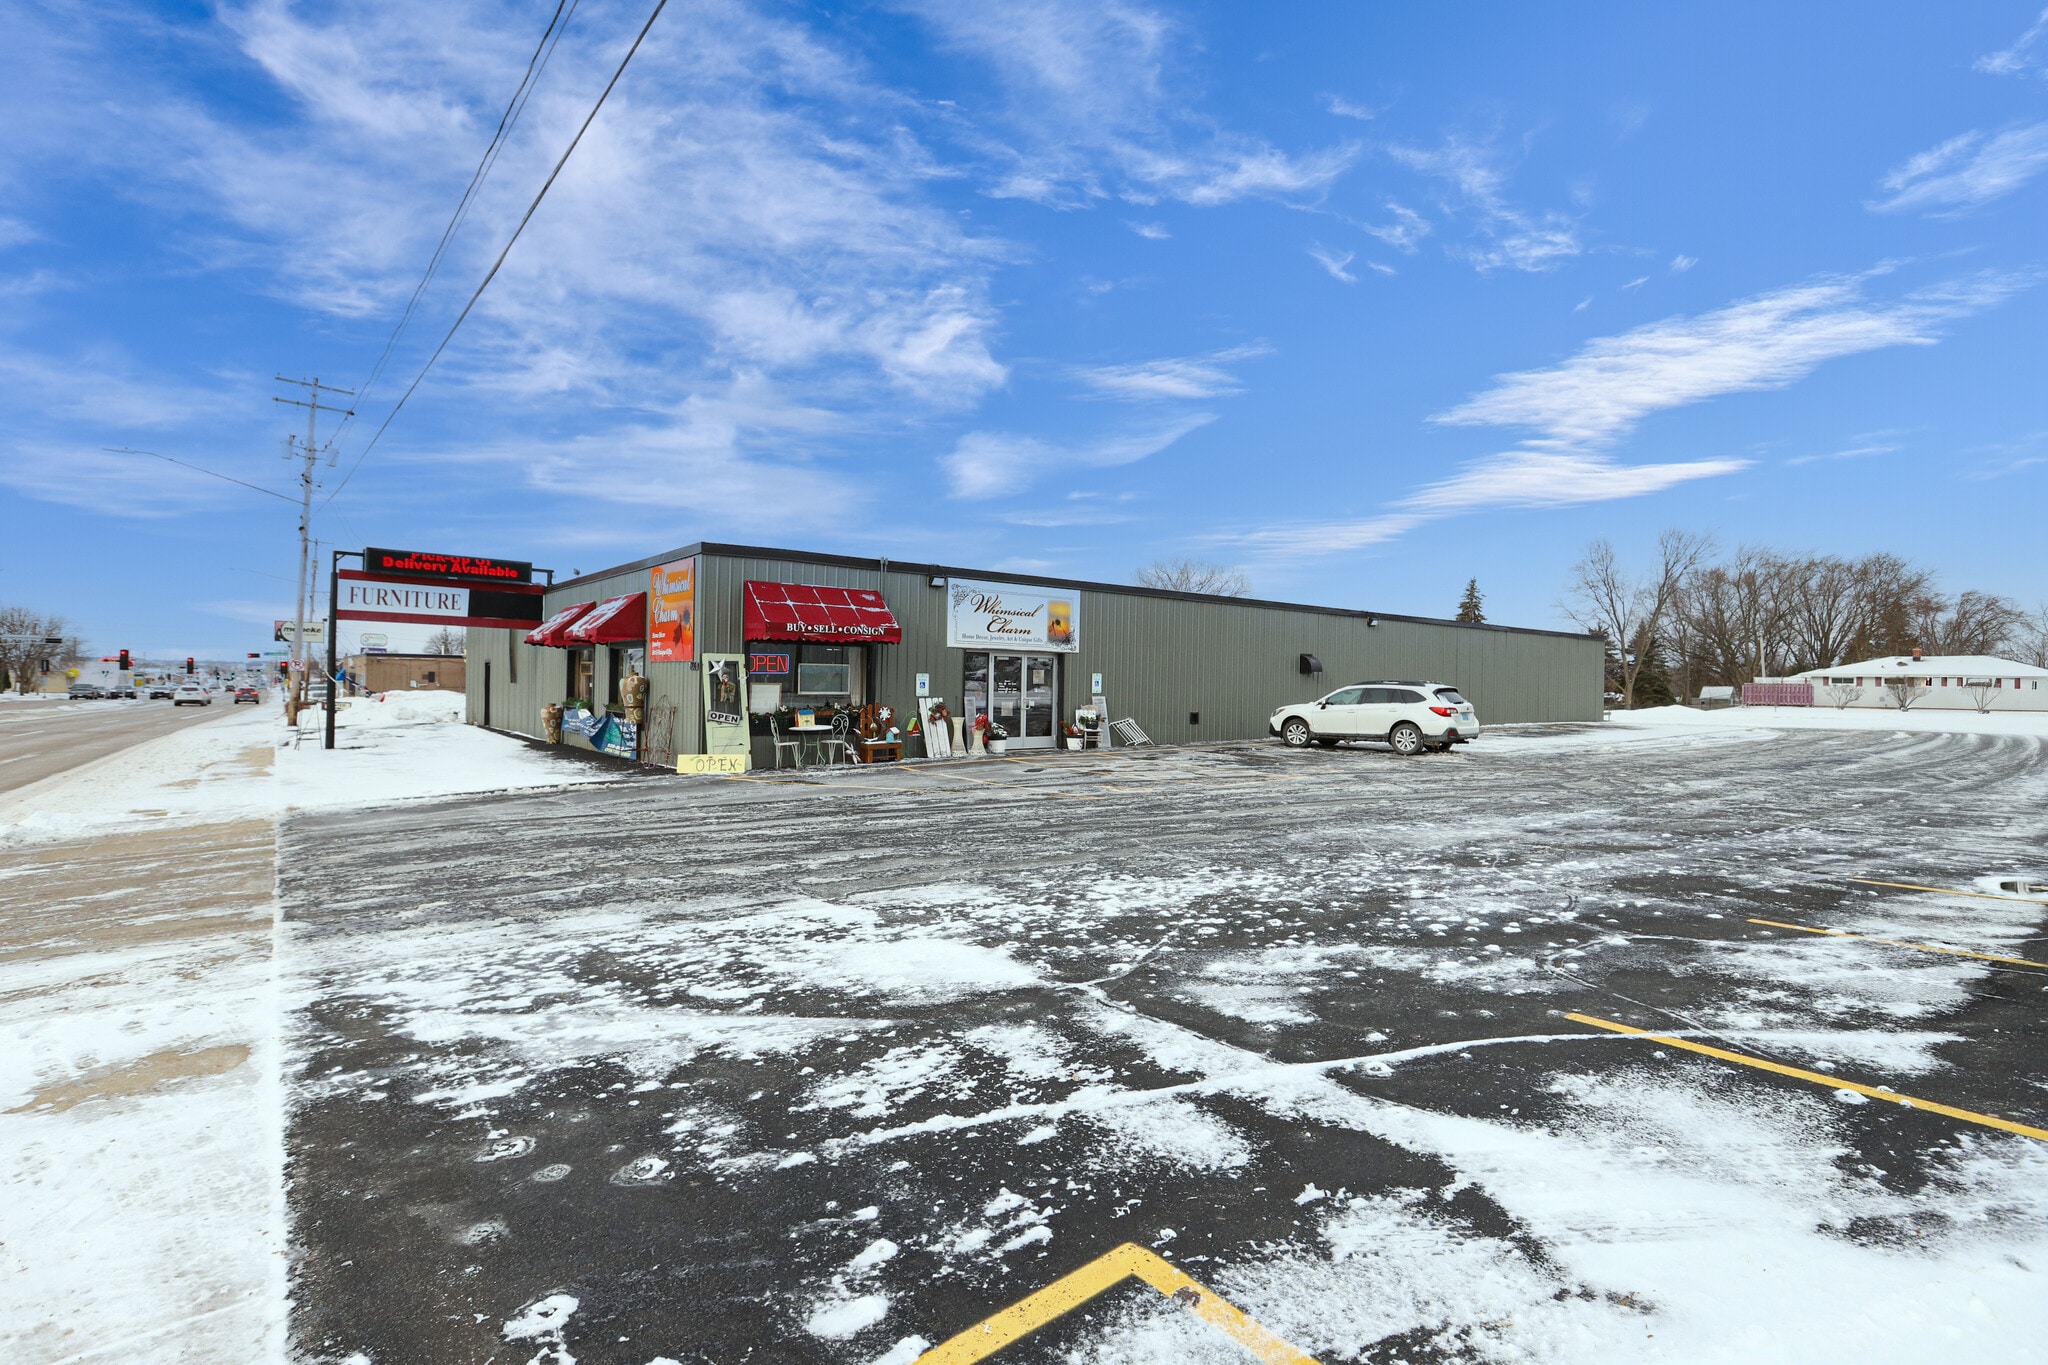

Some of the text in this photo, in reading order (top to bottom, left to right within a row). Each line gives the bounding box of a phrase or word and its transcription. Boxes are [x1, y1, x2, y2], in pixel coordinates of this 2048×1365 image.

[382, 556, 518, 578] Delivery Available
[350, 586, 462, 611] FURNITURE
[970, 593, 1044, 617] Whimsical
[786, 622, 885, 635] BUY SELL CONSIGN
[986, 615, 1032, 635] Charm
[710, 712, 739, 723] OPEN
[696, 756, 738, 772] OPEN
